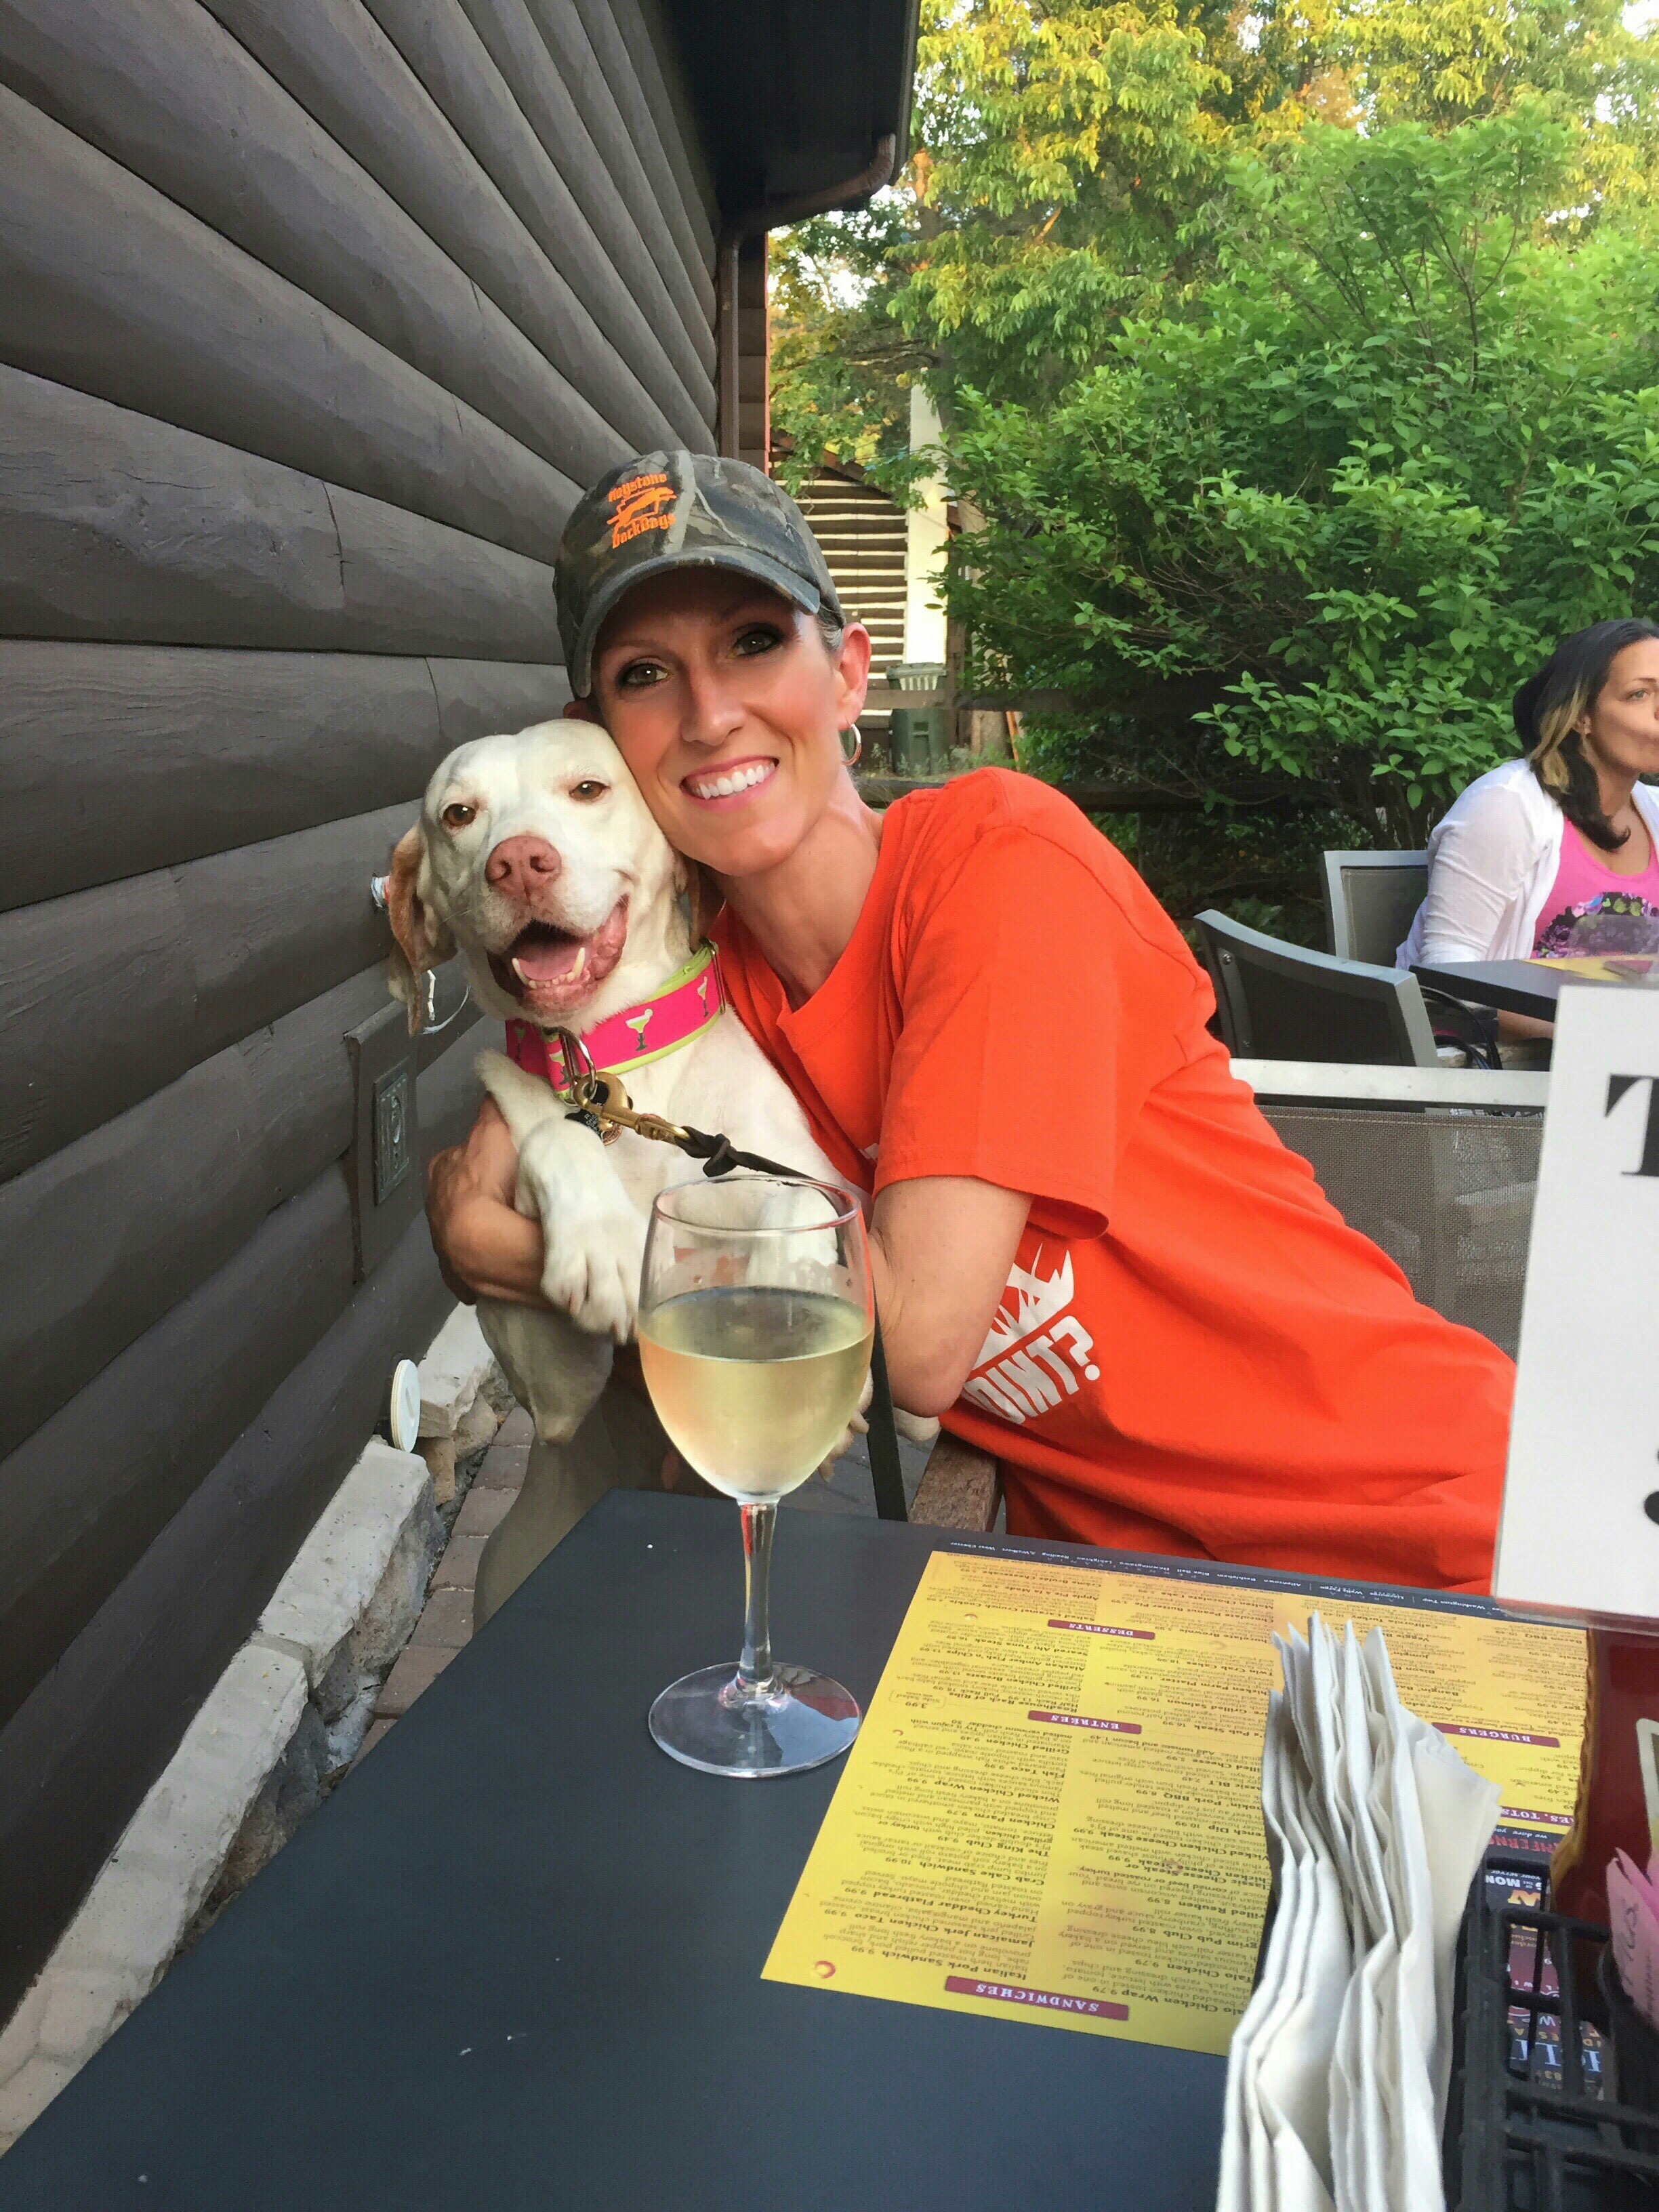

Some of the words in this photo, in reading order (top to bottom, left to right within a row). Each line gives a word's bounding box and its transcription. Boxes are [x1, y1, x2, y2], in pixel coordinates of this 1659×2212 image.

[962, 1315, 1101, 1425] OINT?
[1067, 1622, 1133, 1637] DESSERTS
[945, 1648, 972, 1658] Chips
[1006, 1677, 1045, 1687] Chicken
[1046, 1682, 1082, 1692] Grilled
[947, 1690, 971, 1699] Ribs
[987, 1696, 1015, 1705] Rack
[904, 1699, 928, 1709] 3.99
[1017, 1700, 1078, 1713] Roadhouse
[1166, 1698, 1207, 1708] Salmon
[1193, 1723, 1225, 1733] Steak
[1227, 1728, 1250, 1736] Pub
[1458, 1726, 1531, 1742] BURGERS
[985, 1738, 1027, 1749] Chicken
[1031, 1744, 1069, 1755] Grilled
[1141, 1740, 1158, 1748] and
[1196, 1748, 1214, 1756] Add
[983, 1761, 1004, 1771] 9.99
[1191, 1757, 1231, 1768] Cheese
[1010, 1765, 1037, 1775] Taco
[1041, 1769, 1065, 1779] Fish
[906, 1775, 928, 1785] 9.99
[933, 1779, 965, 1790] Wrap
[1207, 1779, 1230, 1788] BLT
[968, 1784, 1014, 1797] Chicken
[1162, 1791, 1189, 1801] BBQ
[1017, 1790, 1060, 1804] Wicked
[1193, 1796, 1222, 1806] Pork
[945, 1807, 968, 1817] 9.79
[973, 1811, 1005, 1822] Parm
[1008, 1816, 1055, 1830] Chicken
[1207, 1824, 1229, 1834] Dip
[1073, 1826, 1094, 1836] 9.99
[1099, 1830, 1132, 1841] Steak
[1511, 1828, 1532, 1838] dare
[1534, 1832, 1547, 1840] we
[937, 1833, 959, 1844] 9.49
[965, 1837, 992, 1849] Club
[1135, 1835, 1176, 1847] Cheese
[996, 1842, 1023, 1853] King
[1027, 1847, 1050, 1858] The
[1180, 1841, 1226, 1855] Chicken
[1107, 1853, 1130, 1864] 9.99
[1137, 1858, 1172, 1870] Steak
[918, 1860, 977, 1876] Sandwich
[1125, 1862, 1139, 1871] or
[1143, 1864, 1178, 1877] Steak
[1176, 1864, 1221, 1877] Cheese
[980, 1870, 1010, 1881] Cake
[1014, 1875, 1044, 1886] Crab
[1113, 1870, 1151, 1883] roasted
[1182, 1870, 1226, 1884] Cheese
[1225, 1870, 1273, 1885] Chicken
[1167, 1879, 1189, 1888] beef
[844, 1885, 867, 1896] 9.99
[872, 1889, 934, 1907] Flatbread
[1146, 1896, 1170, 1906] 8.99
[823, 1907, 847, 1919] 9.99
[937, 1899, 991, 1916] Cheddar
[1178, 1900, 1226, 1914] Reuben
[853, 1912, 884, 1924] Taco
[994, 1908, 1037, 1923] Turkey
[888, 1917, 939, 1933] Chicken
[1132, 1923, 1156, 1936] 8.99
[943, 1925, 970, 1938] Jerk
[1163, 1927, 1192, 1941] Club
[972, 1930, 1034, 1948] Jamaican
[1196, 1933, 1222, 1946] Pub
[851, 1944, 874, 1957] 9.99
[895, 1944, 926, 1957] pulled
[928, 1948, 966, 1963] roasted
[881, 1949, 943, 1967] Sandwich
[969, 1955, 992, 1967] herb
[1134, 1957, 1159, 1969] 9.79
[947, 1960, 979, 1973] Pork
[995, 1959, 1028, 1973] Italian
[1166, 1962, 1220, 1978] Chicken
[982, 1965, 1026, 1981] Italian
[1092, 1984, 1118, 1997] 9.79
[1120, 1988, 1158, 2003] Wrap
[1149, 1985, 1189, 2000] chicken
[975, 1982, 1100, 2013] SANDWICHES
[1163, 1995, 1218, 2013] Chicken
